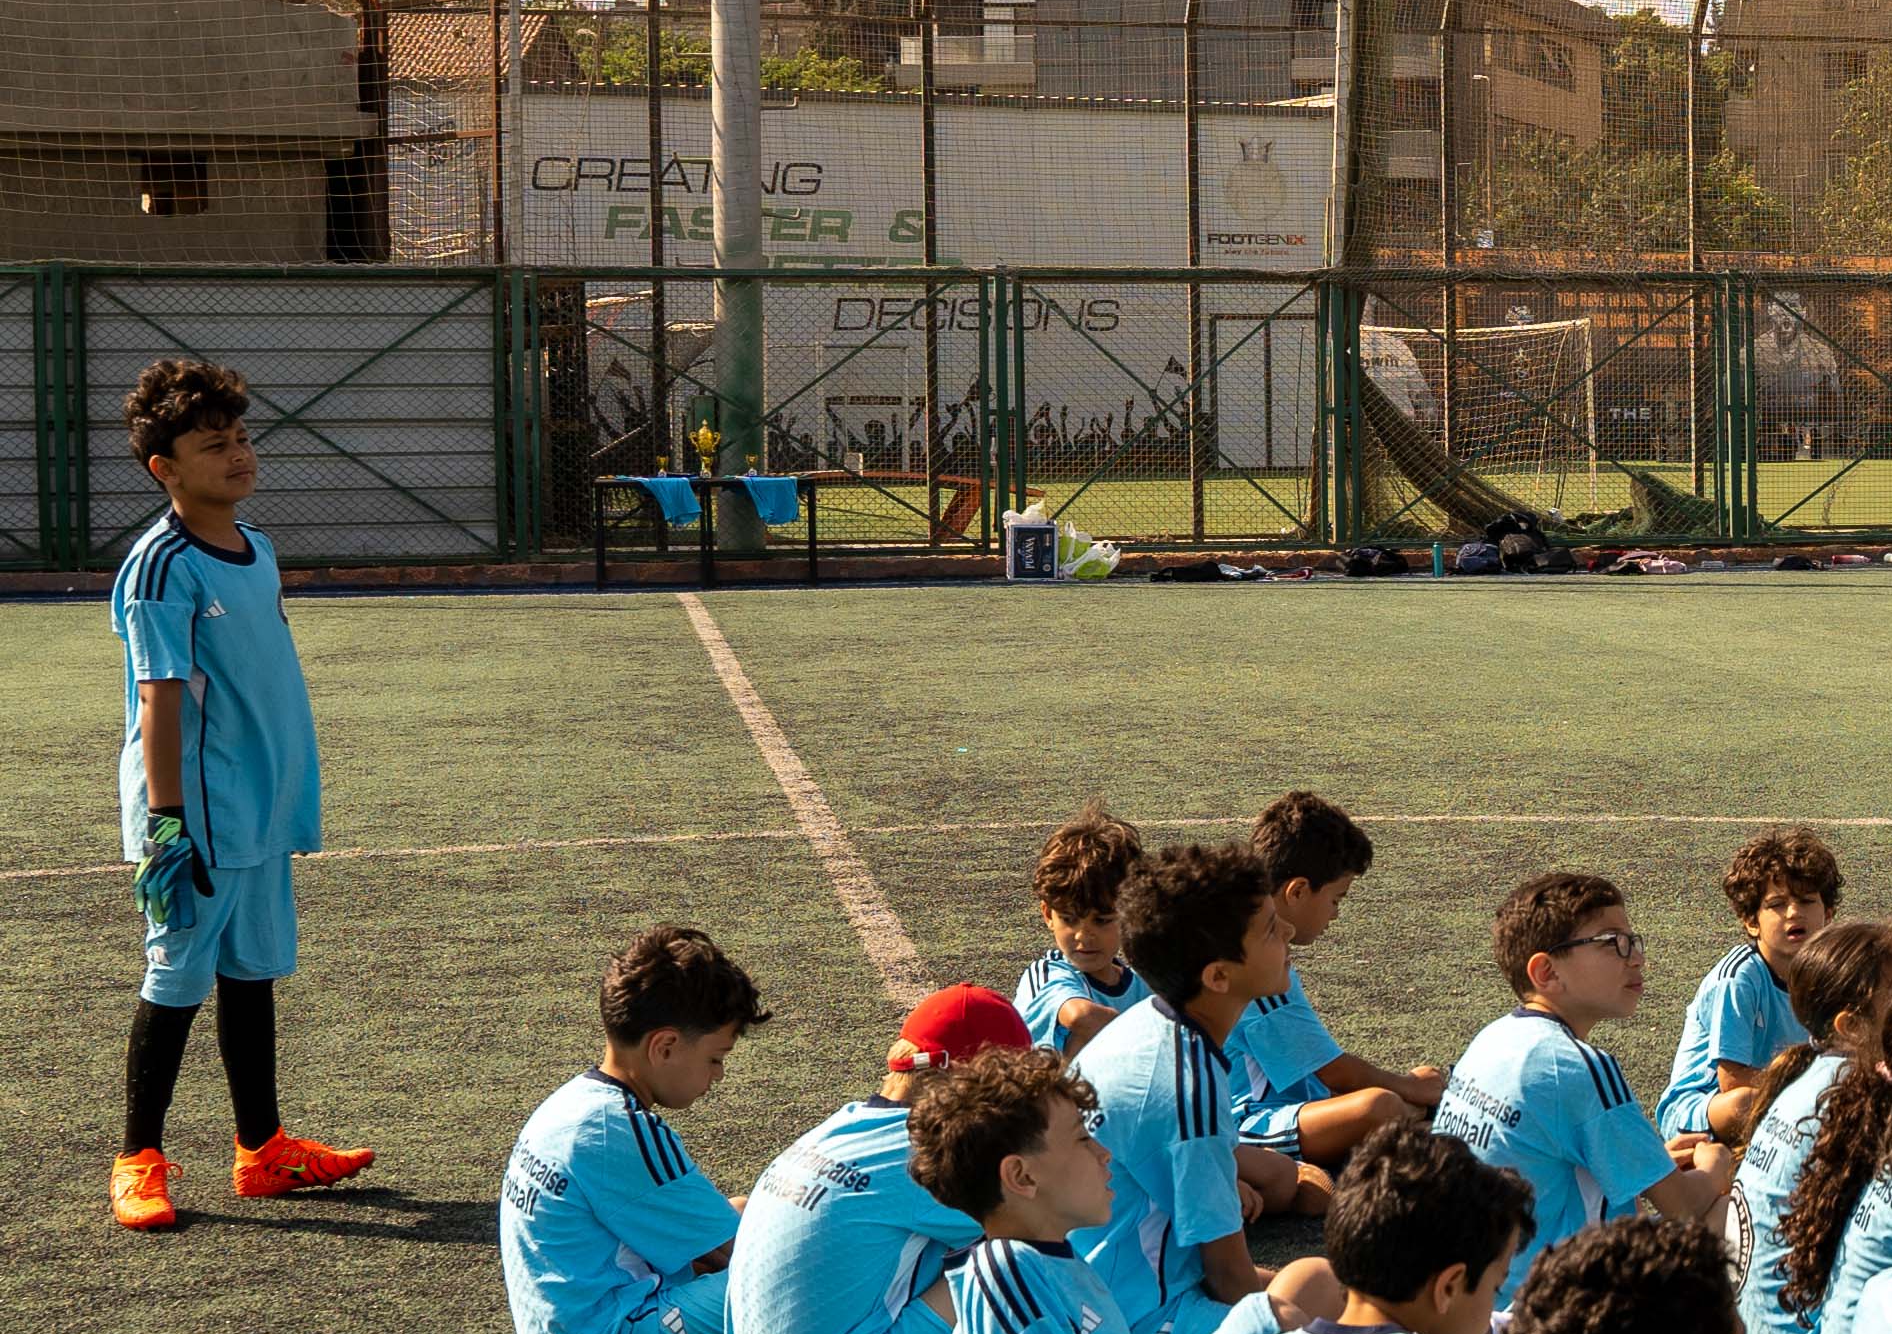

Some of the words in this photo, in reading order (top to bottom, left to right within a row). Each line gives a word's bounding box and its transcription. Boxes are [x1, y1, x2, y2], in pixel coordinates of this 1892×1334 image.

[531, 156, 823, 195] CREATNG
[604, 205, 853, 243] FASER
[833, 297, 1120, 331] DECISONS
[1610, 408, 1651, 420] THE
